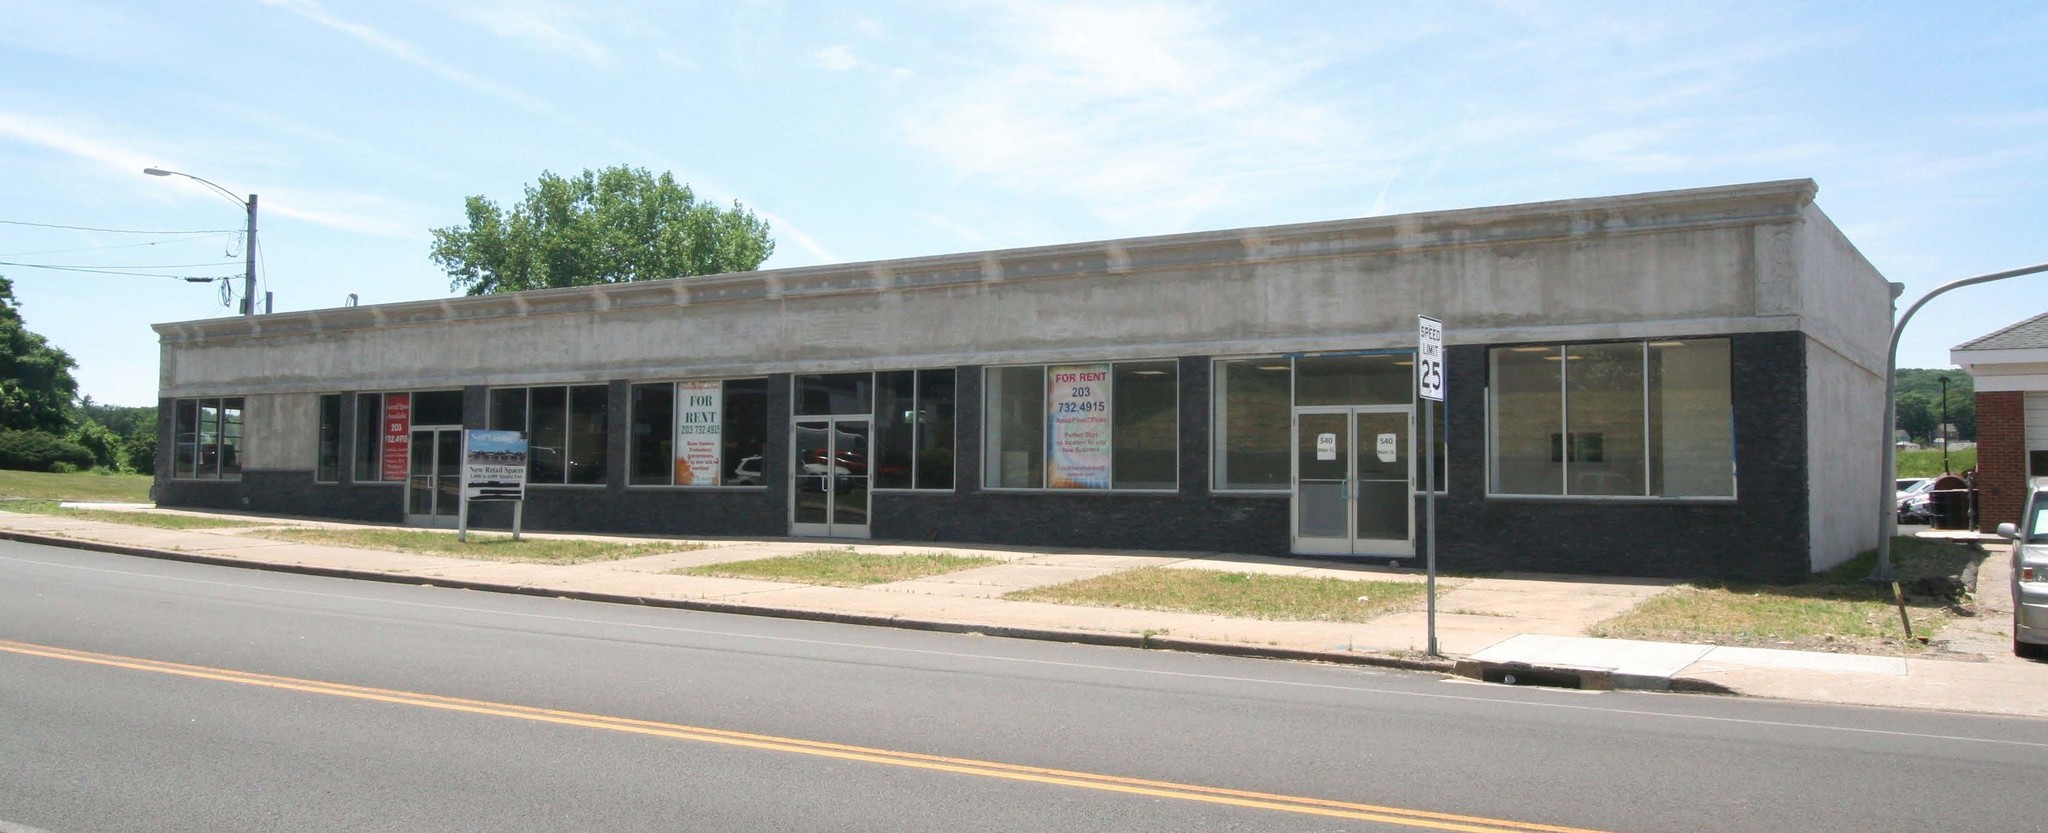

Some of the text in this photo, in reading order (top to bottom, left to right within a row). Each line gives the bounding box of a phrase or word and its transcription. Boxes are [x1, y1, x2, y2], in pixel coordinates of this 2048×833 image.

[1421, 326, 1440, 341] SPEED
[1423, 343, 1438, 356] LIMIT
[1055, 371, 1107, 383] FOR RENT
[1421, 359, 1440, 390] 25
[1072, 387, 1091, 397] 203
[690, 395, 713, 407] FOR
[1058, 401, 1105, 413] 732.4915
[685, 411, 717, 424] RENT
[391, 423, 402, 432] 203
[680, 425, 694, 435] 203
[1319, 437, 1333, 445] 540
[1380, 437, 1394, 445] 540
[503, 466, 524, 475] Spaces
